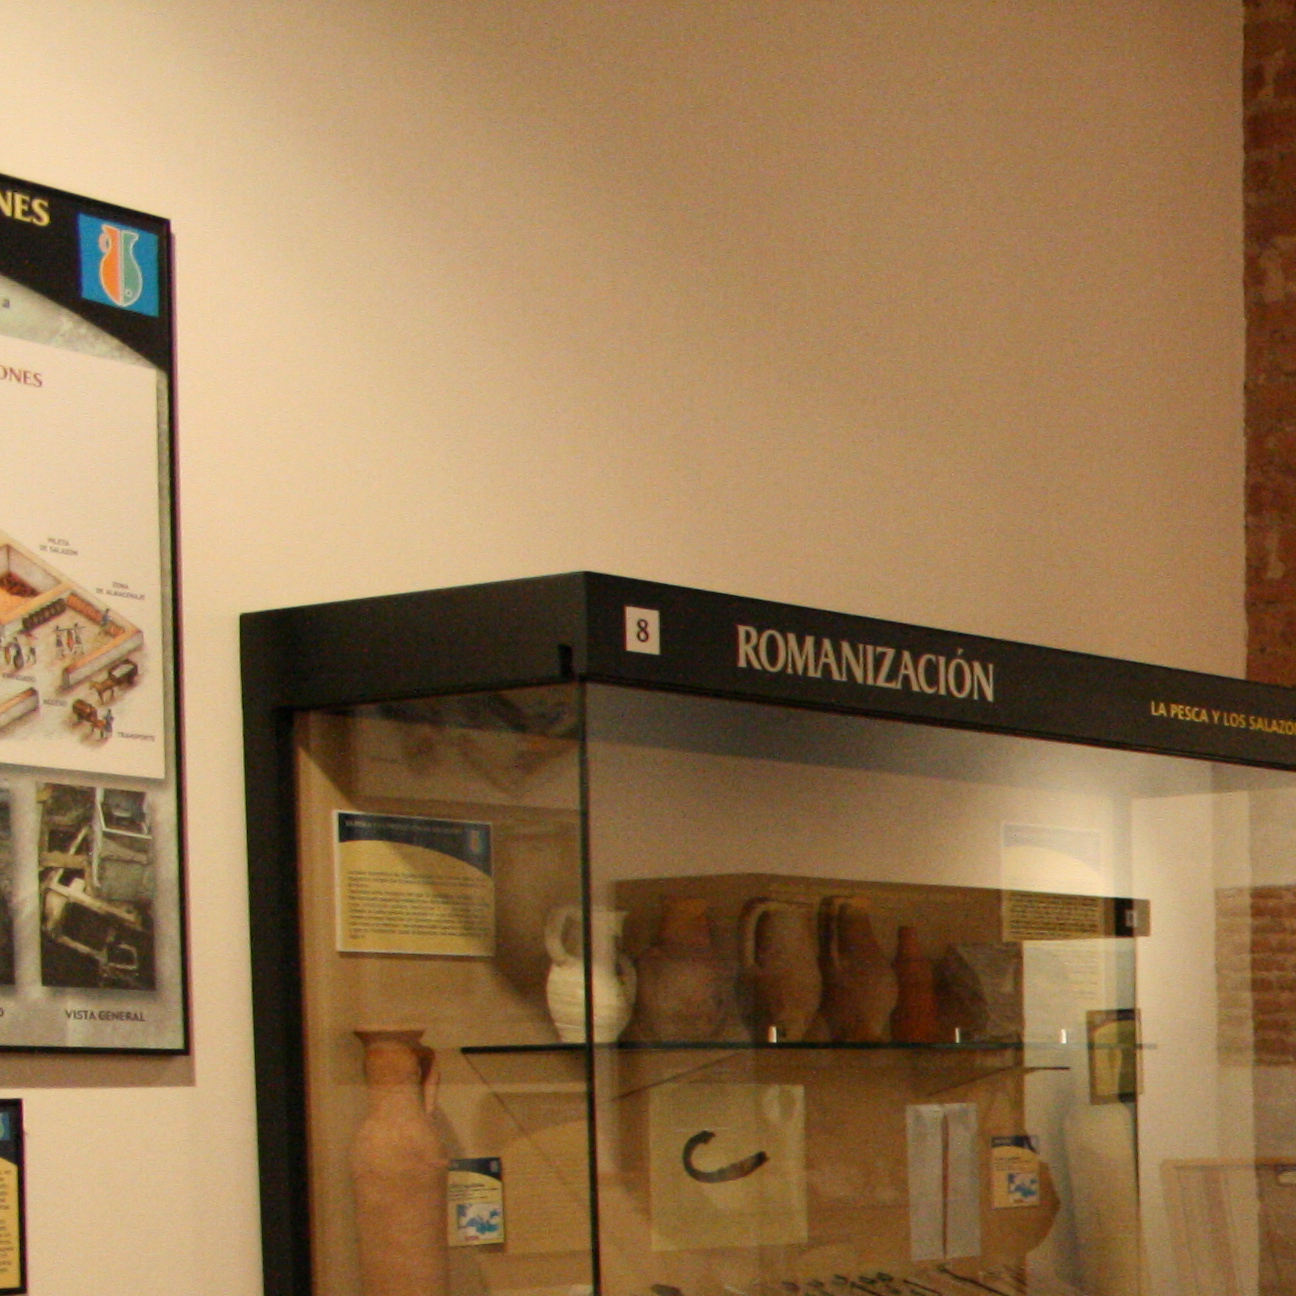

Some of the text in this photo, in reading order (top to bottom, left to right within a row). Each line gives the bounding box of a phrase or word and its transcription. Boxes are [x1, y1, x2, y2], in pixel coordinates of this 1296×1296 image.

[636, 618, 994, 703] 8 ROMANIZACIÓN
[1151, 700, 1167, 717] LA
[1169, 703, 1209, 724] PESCA
[1211, 709, 1221, 724] Y
[1223, 711, 1247, 729] LOS
[65, 1009, 146, 1022] VISTA GENERAL
